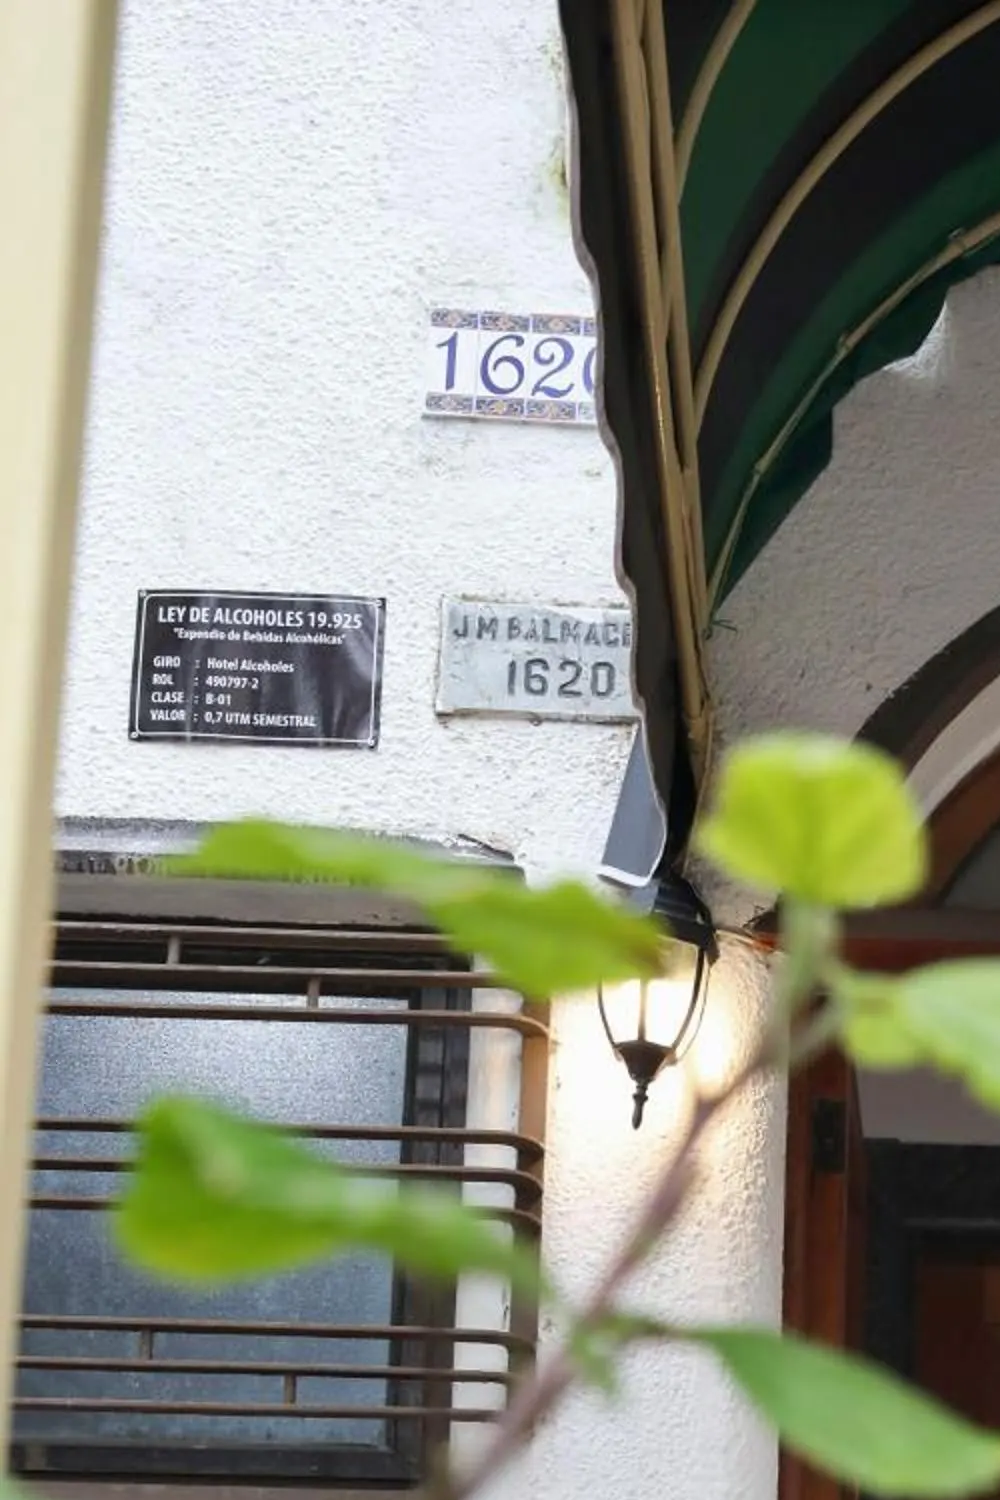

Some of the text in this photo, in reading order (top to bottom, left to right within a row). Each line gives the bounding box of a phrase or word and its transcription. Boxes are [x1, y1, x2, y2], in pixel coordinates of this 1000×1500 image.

[158, 606, 362, 629] LEY DE ALCOHOLES 19.925
[228, 630, 241, 641] de
[243, 631, 284, 643] Bebidas
[153, 656, 181, 669] GIRO
[207, 657, 238, 671] Hotel
[240, 659, 295, 673] Alcoholes
[152, 673, 174, 686] ROL
[507, 657, 617, 699] 1620
[151, 691, 185, 704] CLASE
[149, 709, 187, 722] VALOR
[204, 712, 223, 725] 0,7
[225, 713, 250, 726] UTM
[252, 714, 317, 728] SEMESTRAL
